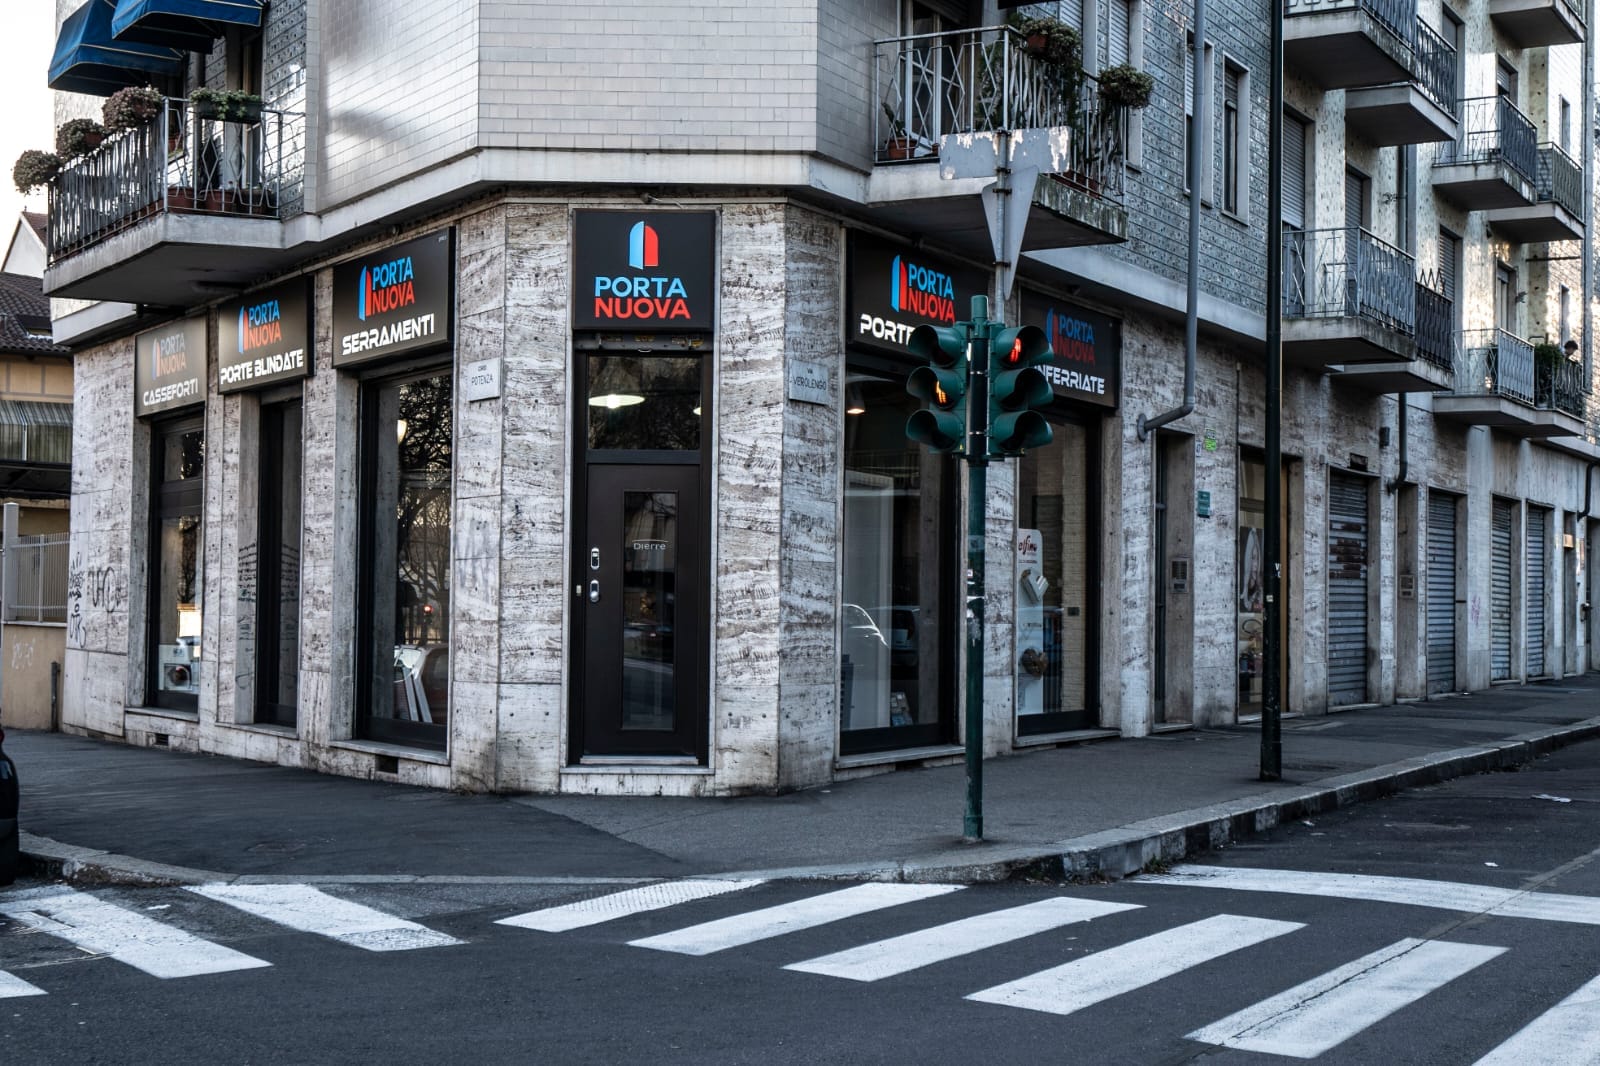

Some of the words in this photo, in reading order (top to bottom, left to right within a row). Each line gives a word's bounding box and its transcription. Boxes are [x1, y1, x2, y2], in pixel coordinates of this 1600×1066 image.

[372, 256, 414, 291] PORTA
[594, 276, 688, 298] PORTA
[908, 263, 955, 300] PORTA
[372, 281, 415, 315] NUOVA
[595, 297, 691, 319] NUOVA
[908, 288, 956, 323] NUOVA
[249, 299, 281, 328] PORTA
[249, 321, 282, 350] NUOVA
[342, 313, 435, 356] SERRAMENTI
[1059, 314, 1095, 345] PORTA
[160, 332, 186, 357] PORTA
[1058, 335, 1096, 366] NUOVA
[160, 352, 187, 376] NUOVA
[220, 360, 253, 385] PORTE
[254, 349, 304, 377] BLINDATE
[143, 377, 199, 406] CASSEFORTI
[471, 373, 494, 386] POTENZA
[792, 376, 827, 391] VEROLENGO
[1034, 364, 1105, 395] NFERRIATE
[633, 542, 666, 551] Dierre
